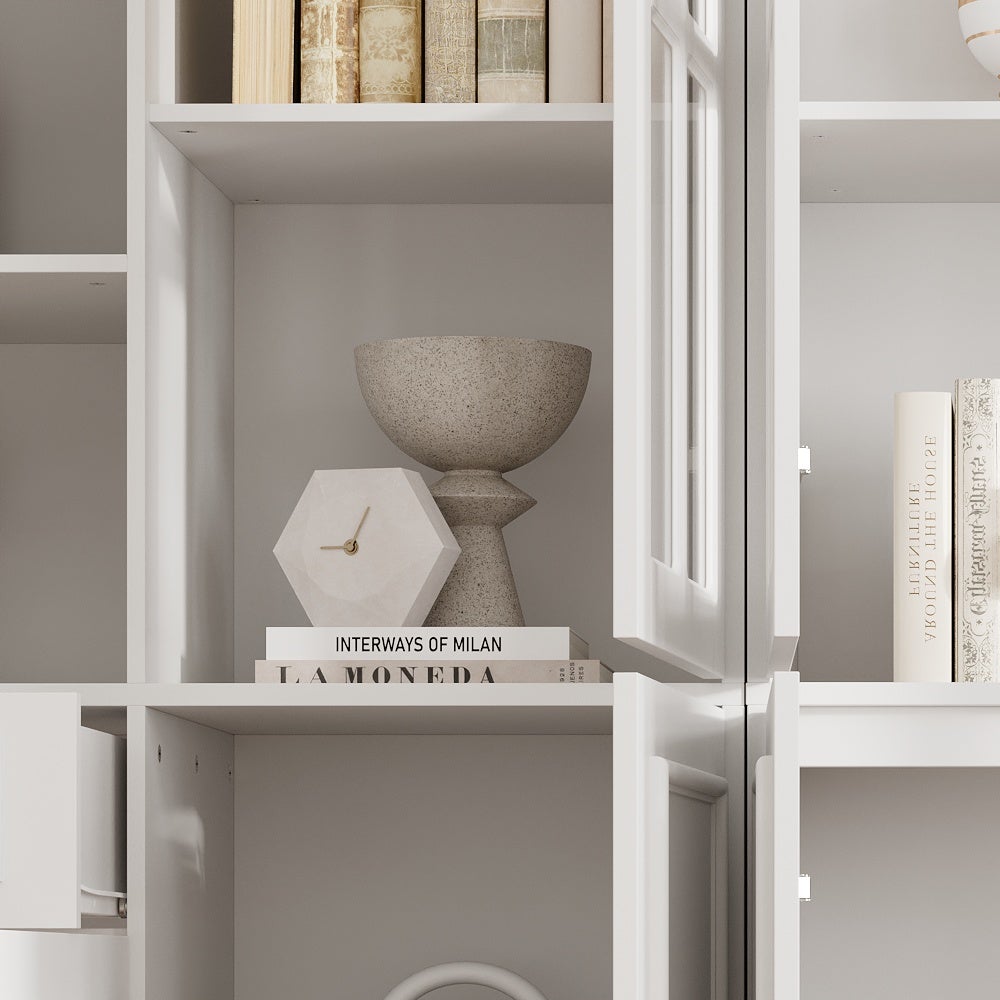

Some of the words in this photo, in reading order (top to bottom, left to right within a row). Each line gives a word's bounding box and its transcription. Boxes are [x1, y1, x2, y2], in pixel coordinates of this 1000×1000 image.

[336, 637, 423, 652] INTERWAYS
[429, 637, 448, 652] OF
[454, 637, 502, 652] MILAN
[275, 666, 328, 684] LA
[343, 666, 495, 684] MONEDA
